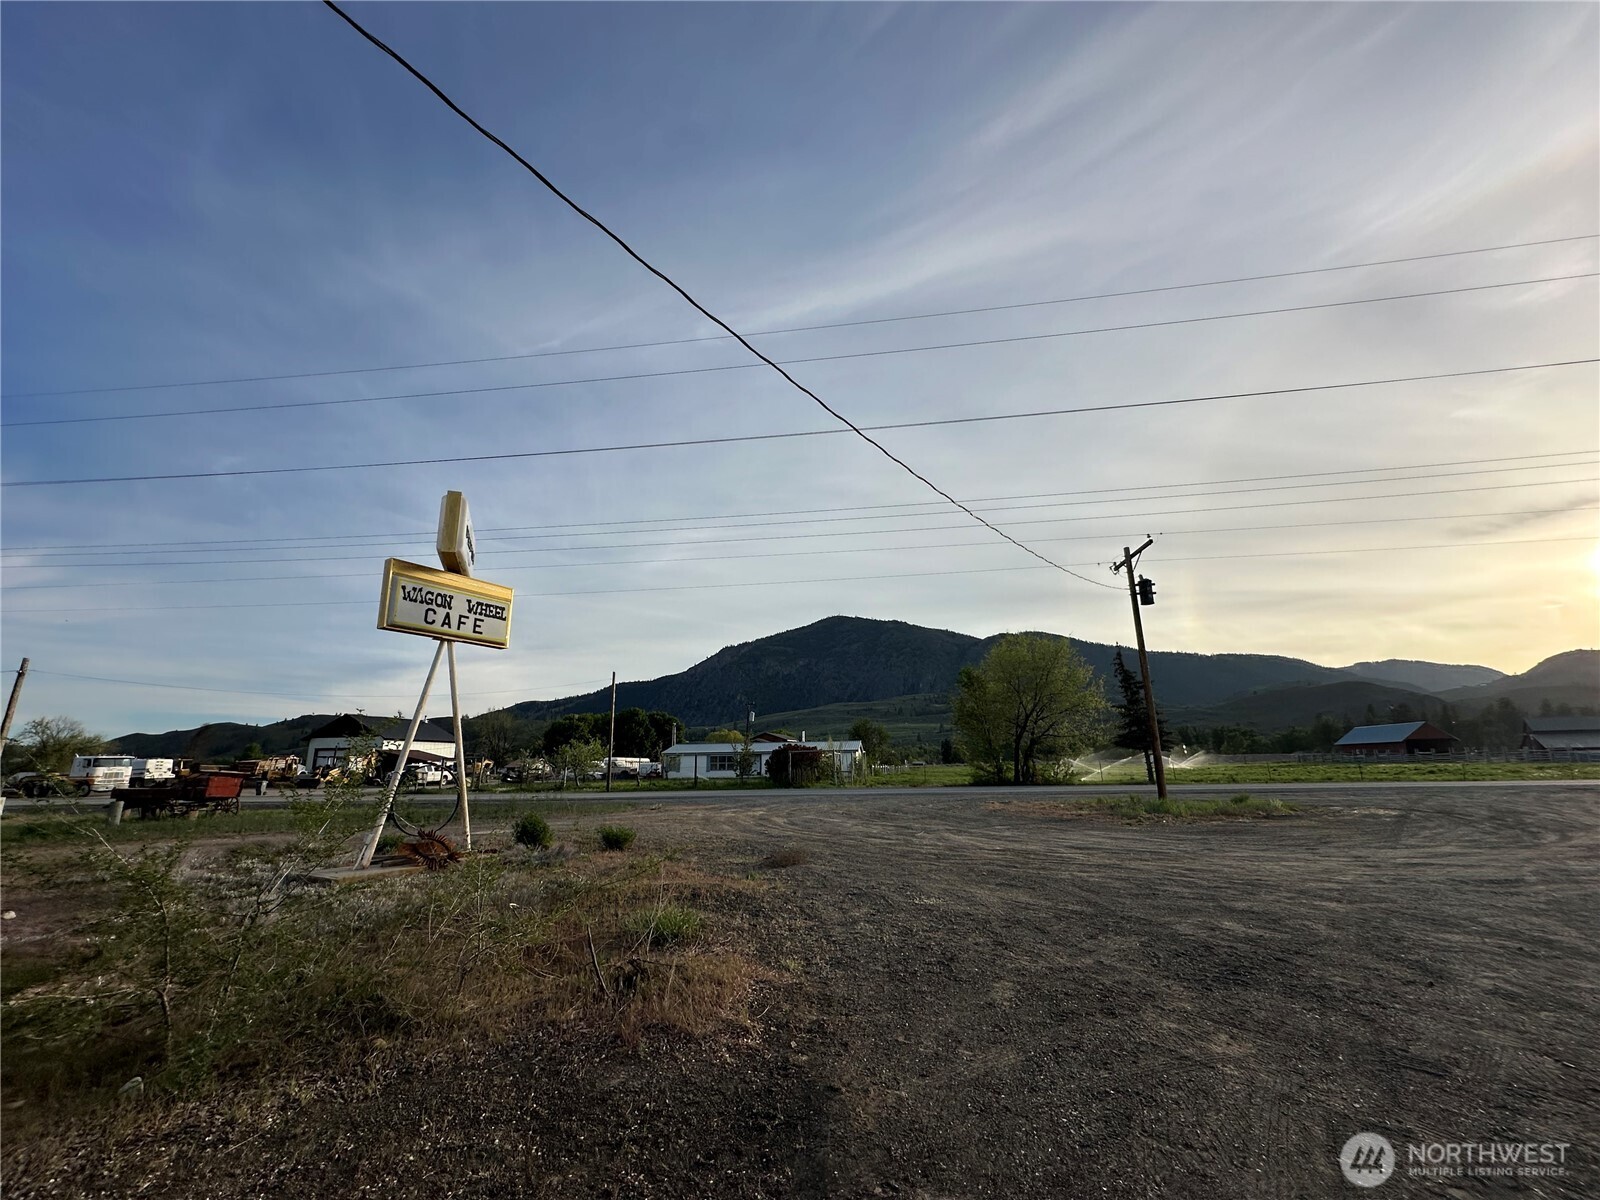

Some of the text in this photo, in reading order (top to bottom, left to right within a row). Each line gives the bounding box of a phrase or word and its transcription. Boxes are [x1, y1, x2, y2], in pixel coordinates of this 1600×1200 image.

[401, 585, 507, 622] WAGON WHEEL
[424, 608, 485, 635] CAFE
